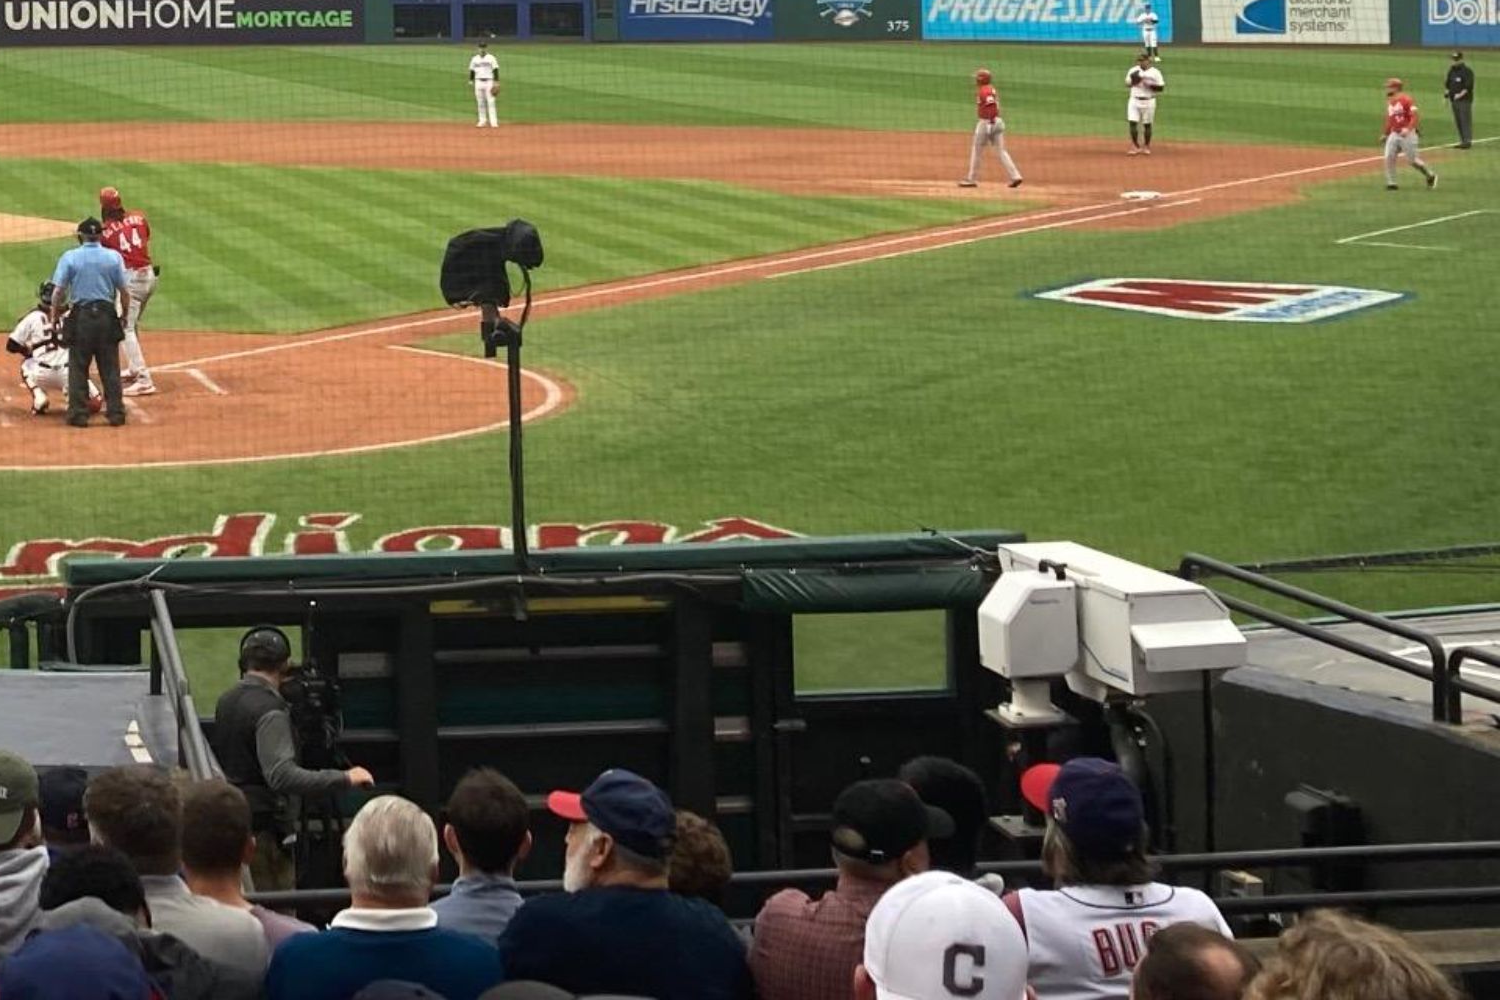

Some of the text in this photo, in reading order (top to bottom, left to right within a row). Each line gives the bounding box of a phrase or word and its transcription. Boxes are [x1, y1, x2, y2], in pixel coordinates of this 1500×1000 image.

[236, 10, 352, 28] MORTGAGE
[1289, 6, 1351, 19] merchant
[887, 20, 910, 32] 375
[1289, 21, 1346, 35] systems
[119, 227, 142, 252] 44
[943, 943, 986, 998] C
